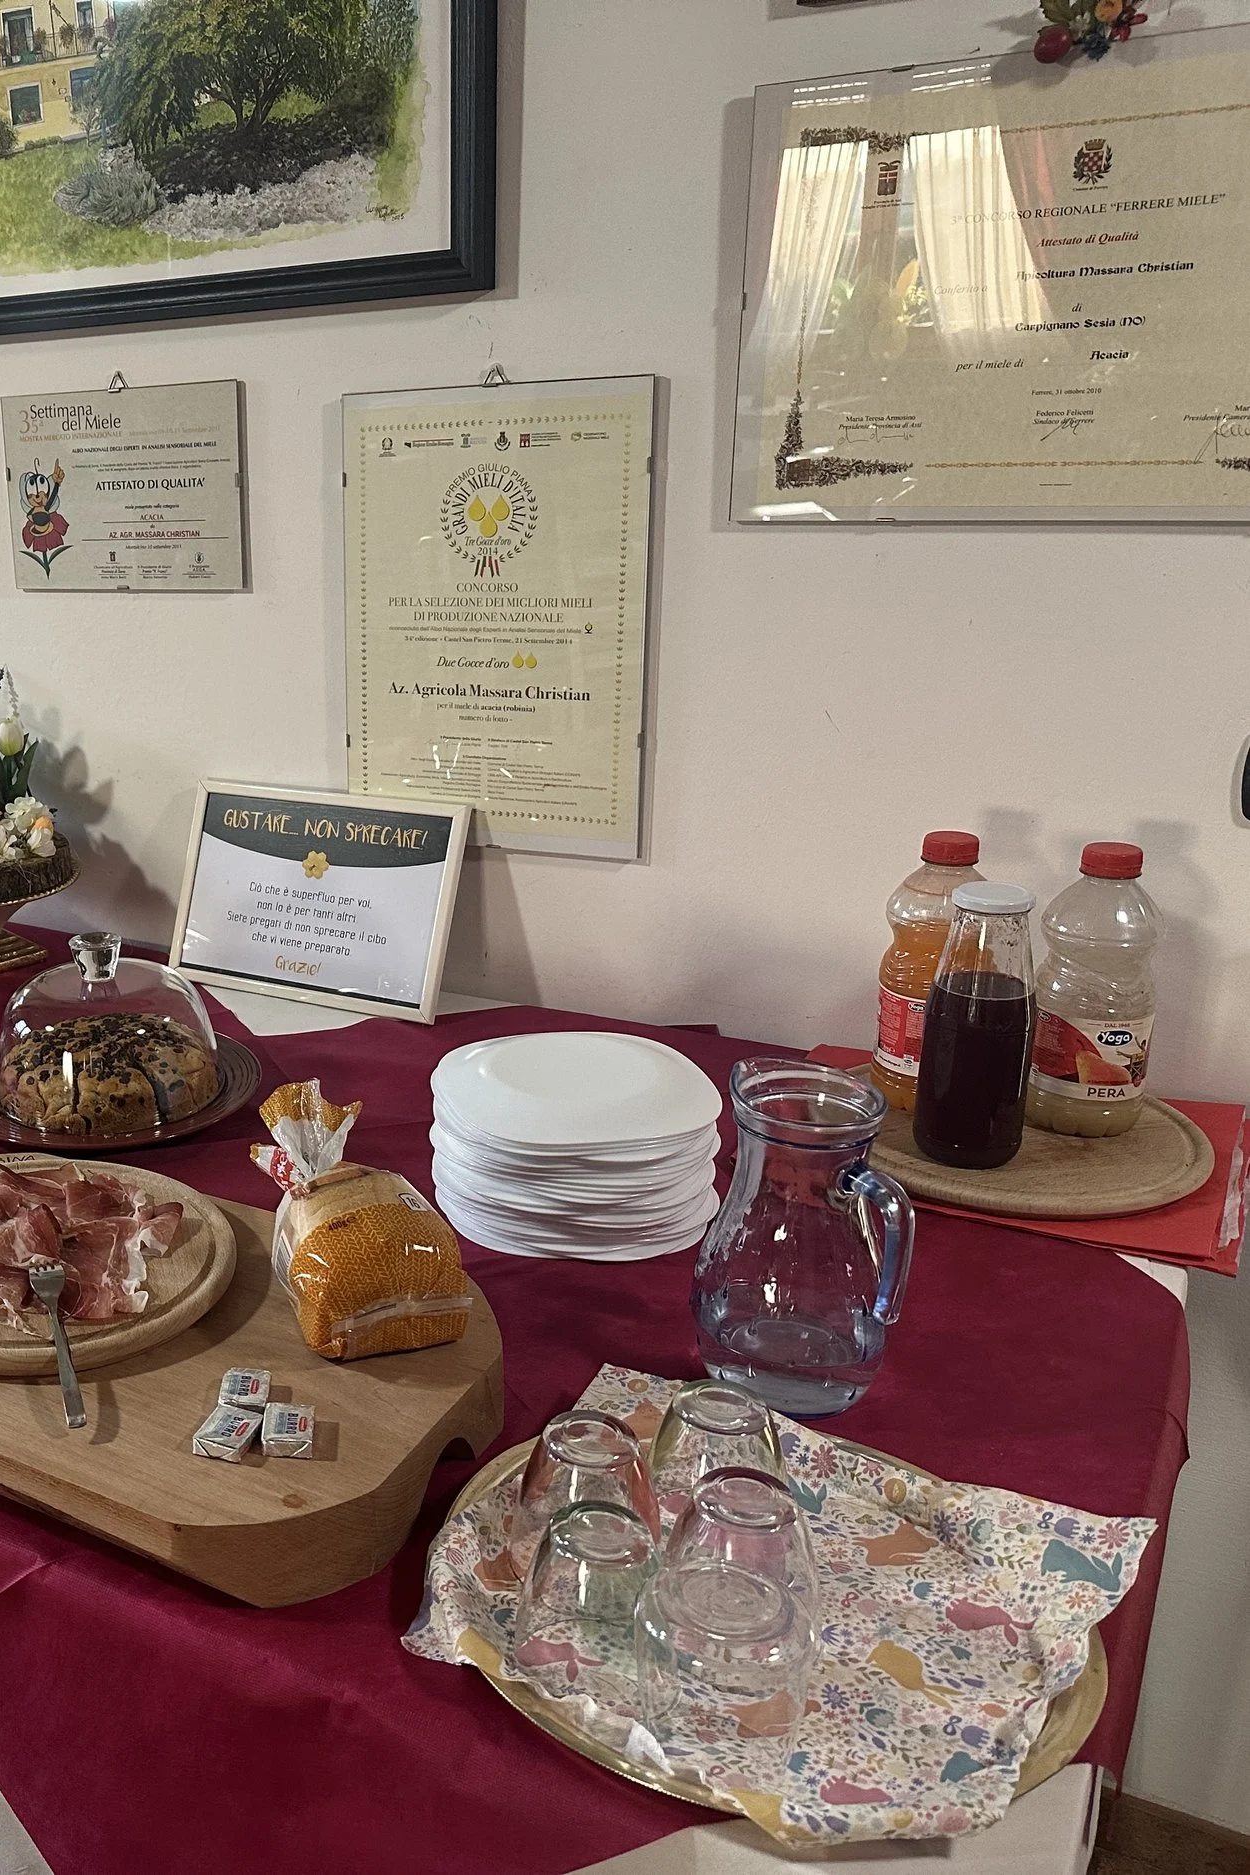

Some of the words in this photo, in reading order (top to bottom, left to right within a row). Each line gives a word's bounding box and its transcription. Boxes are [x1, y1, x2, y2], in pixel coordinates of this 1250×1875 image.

[1034, 203, 1107, 219] REGIONALE
[1037, 236, 1082, 248] Attestato
[1085, 234, 1096, 245] di
[1098, 231, 1139, 245] Qualità
[1015, 268, 1075, 282] Apicoltura
[1079, 265, 1133, 278] Massara
[1138, 260, 1194, 274] Christian
[934, 284, 979, 296] Conferito
[1071, 303, 1082, 313] di
[1015, 319, 1080, 332] Carpignano
[1083, 318, 1116, 328] Sesia
[1119, 315, 1146, 327] (NO)
[1089, 350, 1130, 361] Acacia
[955, 361, 973, 372] per
[975, 359, 982, 369] il
[984, 359, 1012, 369] miele
[1013, 358, 1024, 368] di
[30, 403, 92, 420] Settimana
[62, 416, 81, 432] del
[85, 413, 121, 430] Miele
[95, 479, 145, 491] ATTESTATO
[148, 479, 158, 490] DI
[445, 467, 476, 498] PREMIO
[477, 463, 510, 474] GIULIO
[510, 470, 534, 497] PIANA
[451, 486, 471, 536] GRANDI
[470, 472, 503, 493] MIELI
[502, 478, 527, 533] D'ITALIA
[464, 536, 475, 546] Tre
[475, 536, 494, 546] Gocce
[477, 547, 498, 556] 2014
[456, 582, 519, 593] CONCORSO
[388, 596, 408, 607] PER
[409, 597, 423, 607] LA
[424, 597, 483, 608] SELEZIONE
[485, 597, 504, 608] DEI
[506, 597, 558, 609] MIGLIORI
[560, 597, 593, 609] MIELI
[413, 611, 425, 622] DI
[427, 611, 498, 622] PRODUZIONE
[499, 611, 564, 623] NAZIONALE
[437, 656, 456, 667] Due
[457, 656, 484, 668] Gocce
[485, 656, 510, 669] d'oro
[388, 681, 409, 695] Az.
[412, 682, 467, 699] Agricola
[469, 684, 522, 699] Massara
[525, 685, 591, 702] Christian
[502, 704, 536, 714] (robinia)
[304, 818, 340, 839] NON
[344, 821, 429, 851] SPRECARE!
[249, 881, 262, 893] Ciò
[264, 884, 280, 895] che
[283, 885, 289, 897] è
[291, 889, 335, 904] superfluo
[338, 895, 354, 908] per
[256, 900, 273, 911] non
[275, 901, 283, 912] lo
[294, 905, 310, 918] per
[313, 907, 333, 920] tanti
[227, 910, 247, 924] Siete
[250, 914, 281, 930] pregati
[284, 918, 292, 931] di
[294, 922, 311, 933] non
[313, 925, 356, 941] sprecare
[358, 930, 365, 941] il
[367, 931, 387, 945] cibo
[251, 931, 267, 943] che
[270, 934, 277, 945] vi
[279, 935, 302, 948] viene
[275, 955, 322, 978] Grazie!
[1101, 1030, 1131, 1046] Yoga
[1087, 1087, 1126, 1098] PERA
[237, 1375, 252, 1396] BURRO
[221, 1416, 245, 1438] BURRO
[286, 1412, 299, 1435] BURRO
